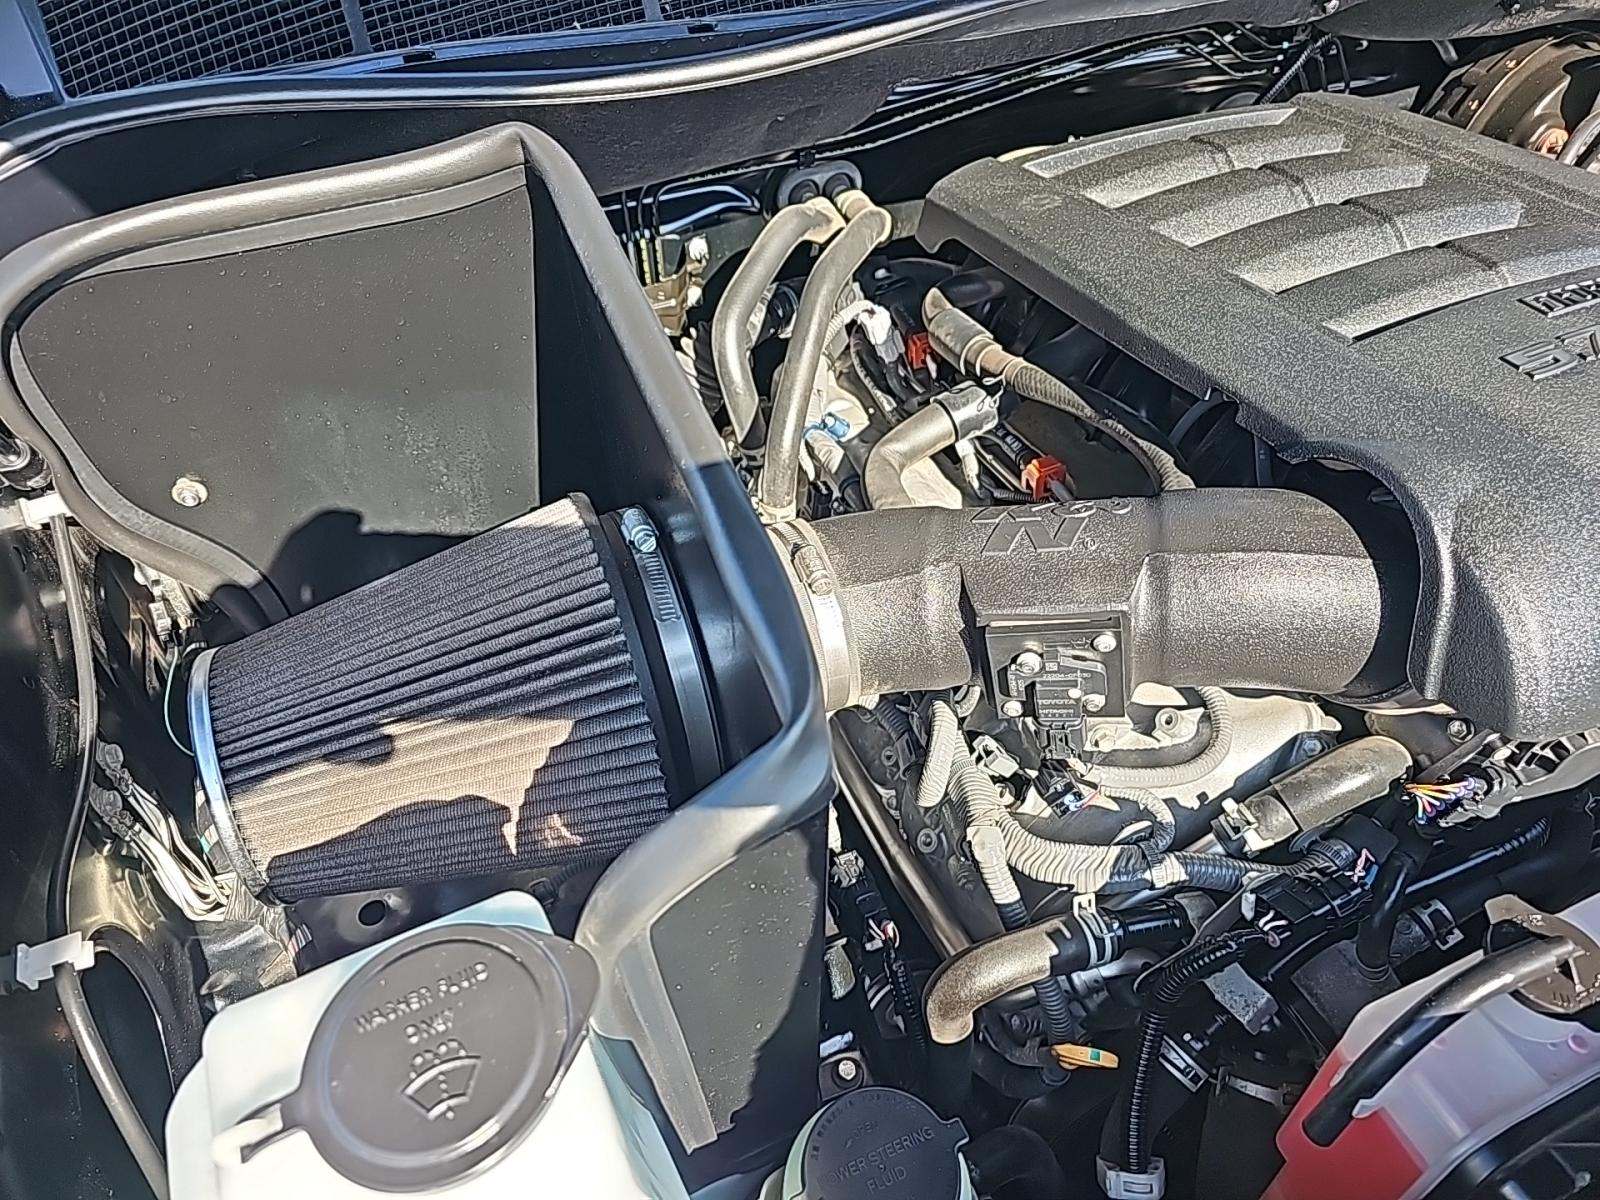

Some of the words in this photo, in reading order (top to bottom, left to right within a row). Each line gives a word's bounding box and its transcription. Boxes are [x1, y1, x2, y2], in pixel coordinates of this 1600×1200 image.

[354, 986, 434, 1034] WASHER
[437, 961, 489, 999] FLUID
[867, 1126, 935, 1165] STEERING
[865, 1166, 907, 1195] FLUID
